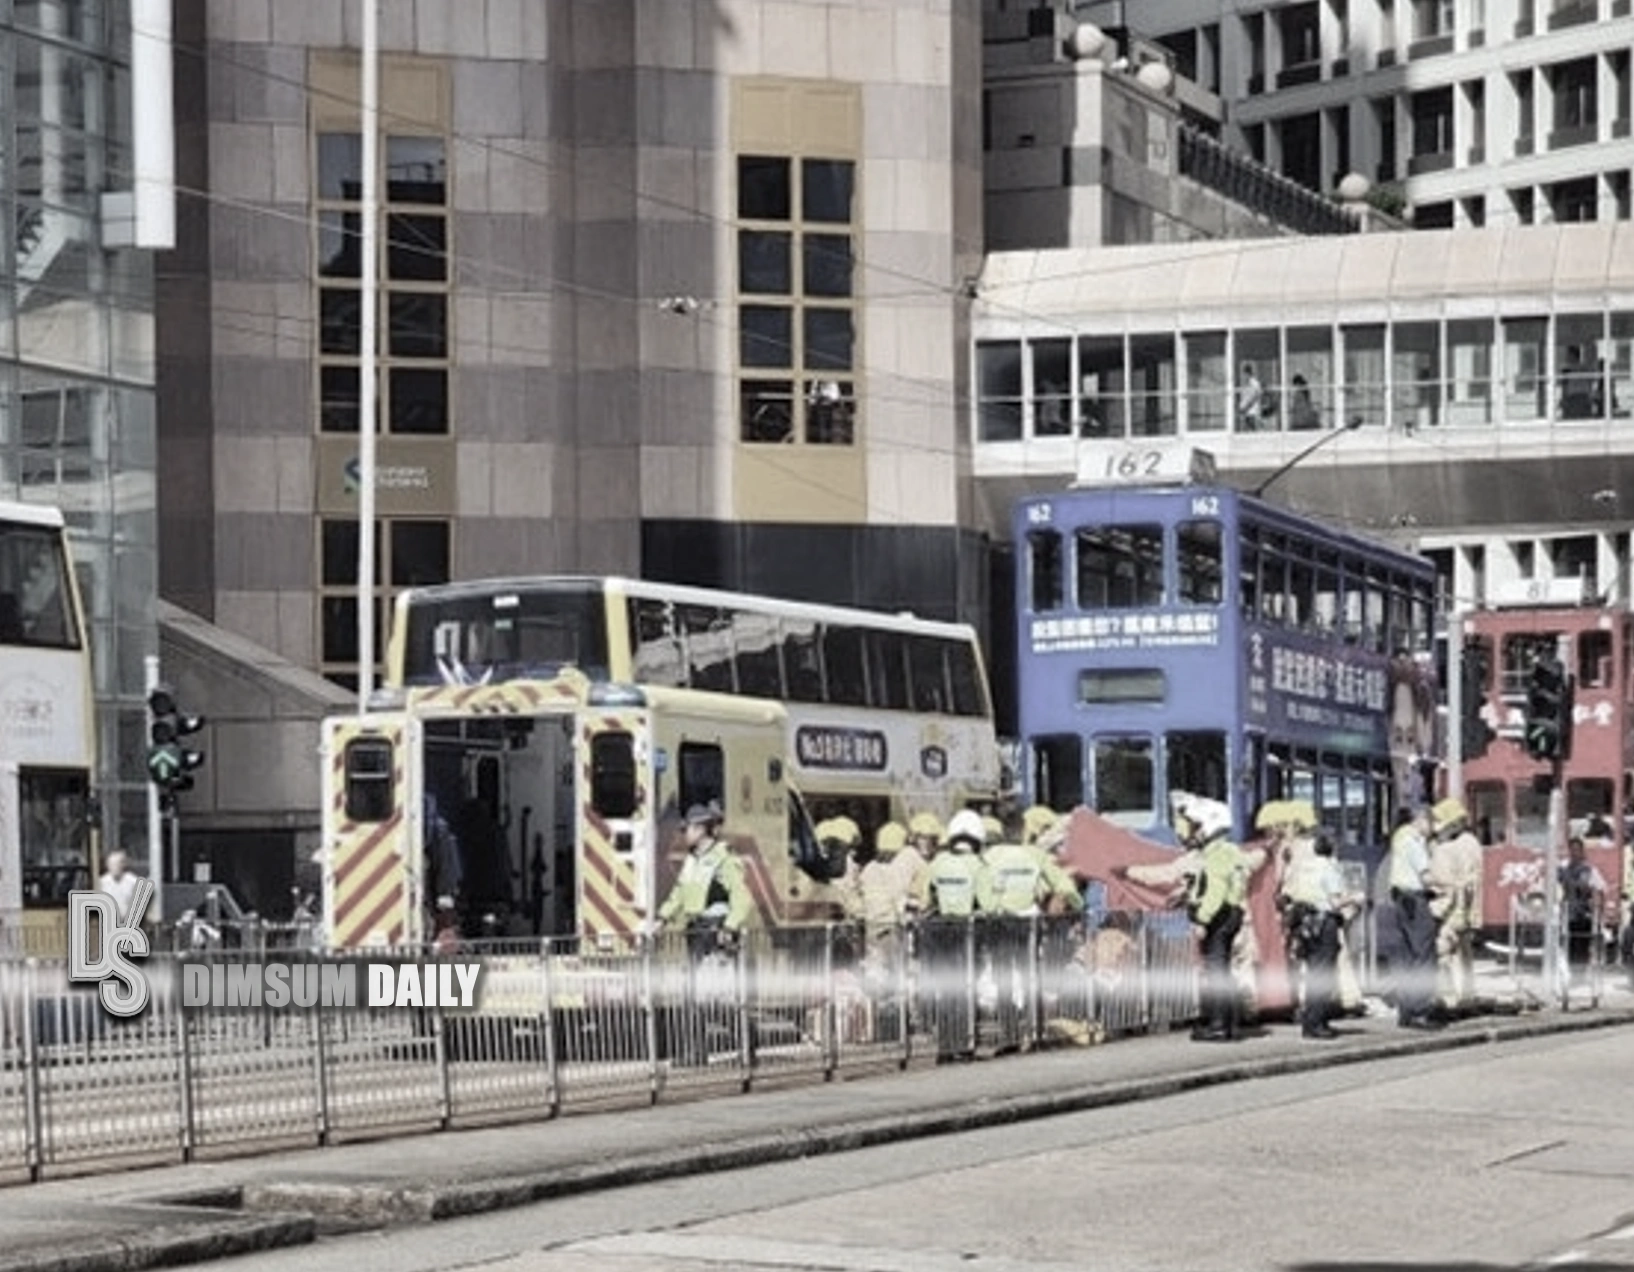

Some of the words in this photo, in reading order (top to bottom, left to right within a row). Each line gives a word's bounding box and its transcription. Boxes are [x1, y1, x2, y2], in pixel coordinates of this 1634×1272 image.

[1105, 451, 1162, 477] 162
[1028, 503, 1051, 523] 162
[1192, 496, 1219, 515] 162
